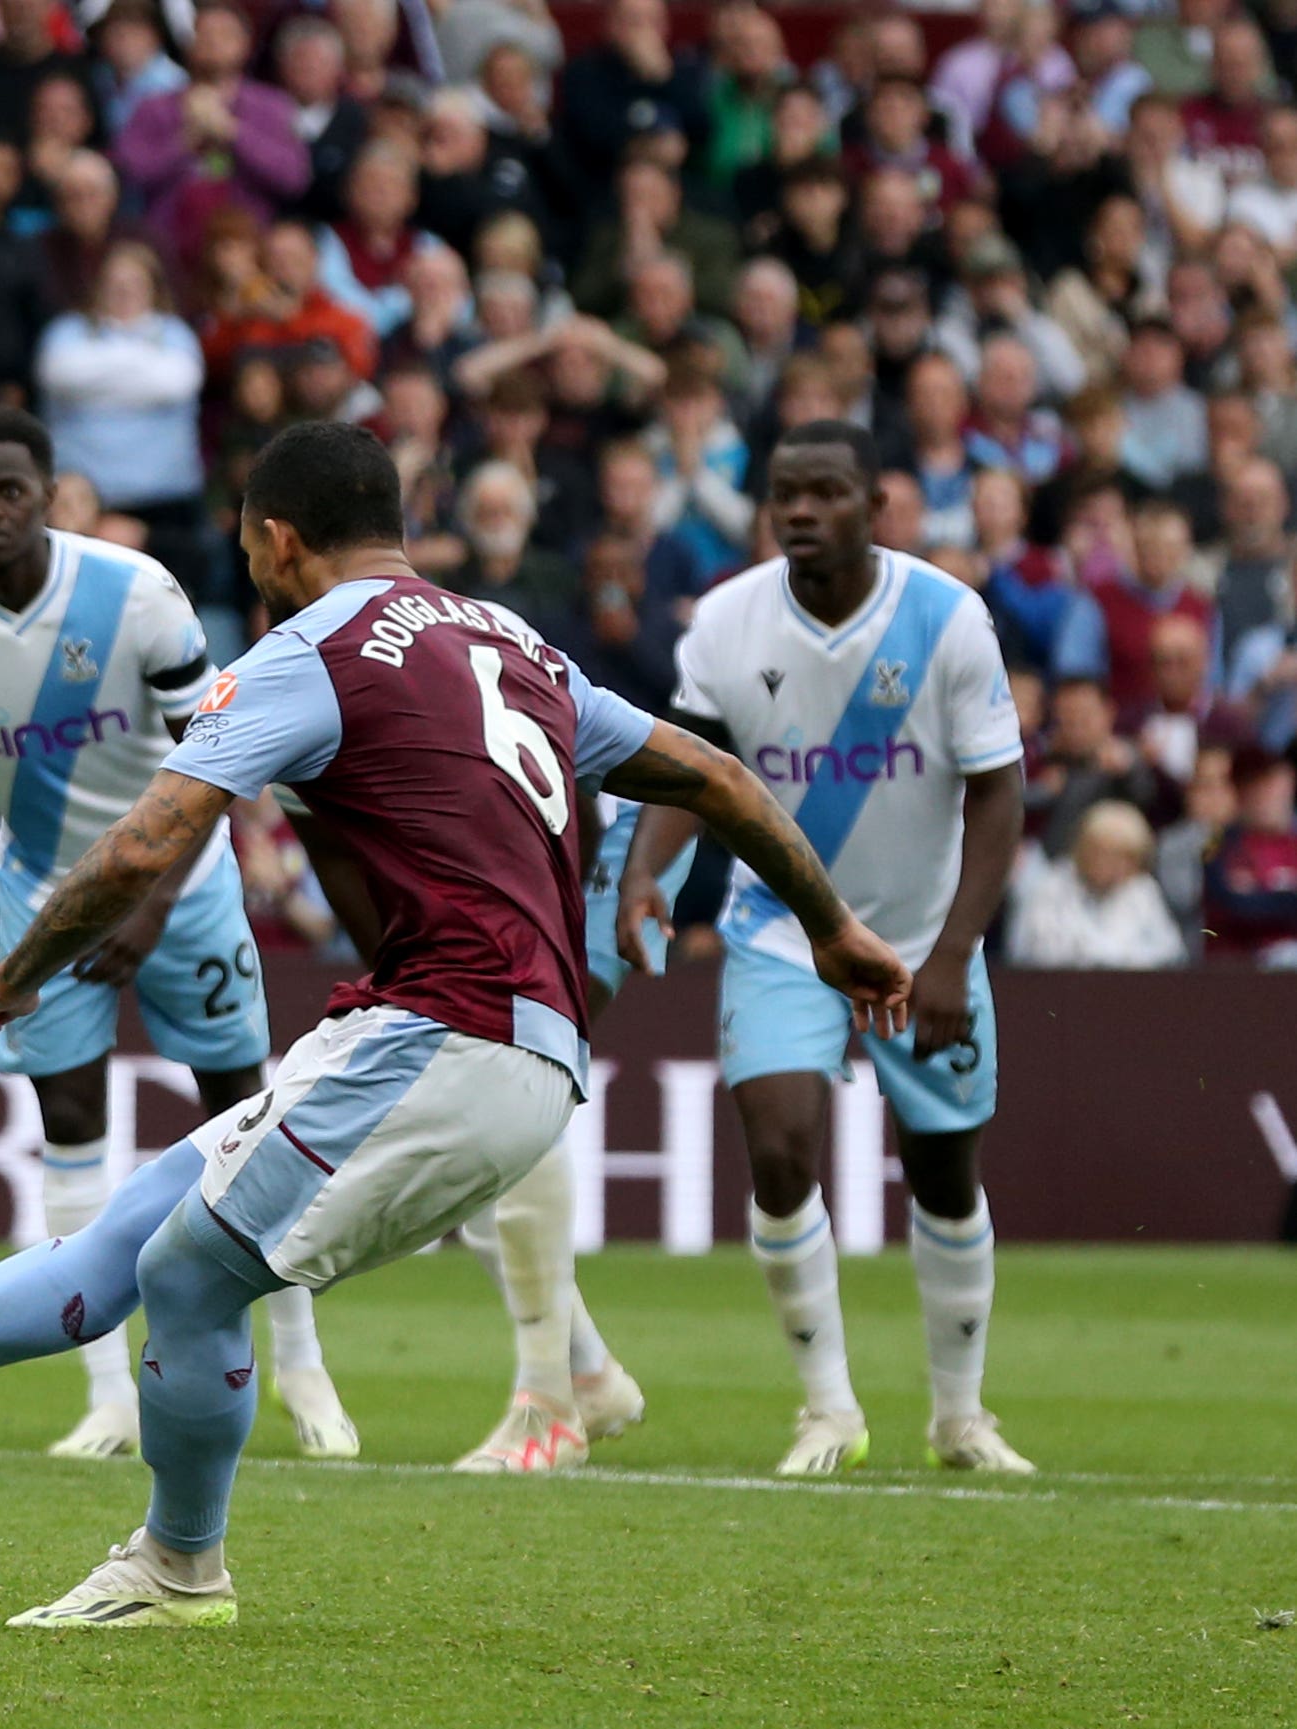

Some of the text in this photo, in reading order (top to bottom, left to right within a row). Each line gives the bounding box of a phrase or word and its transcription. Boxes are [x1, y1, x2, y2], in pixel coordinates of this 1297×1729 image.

[360, 594, 491, 669] DOUGLAS
[468, 644, 570, 836] 6
[756, 726, 925, 784] cinch
